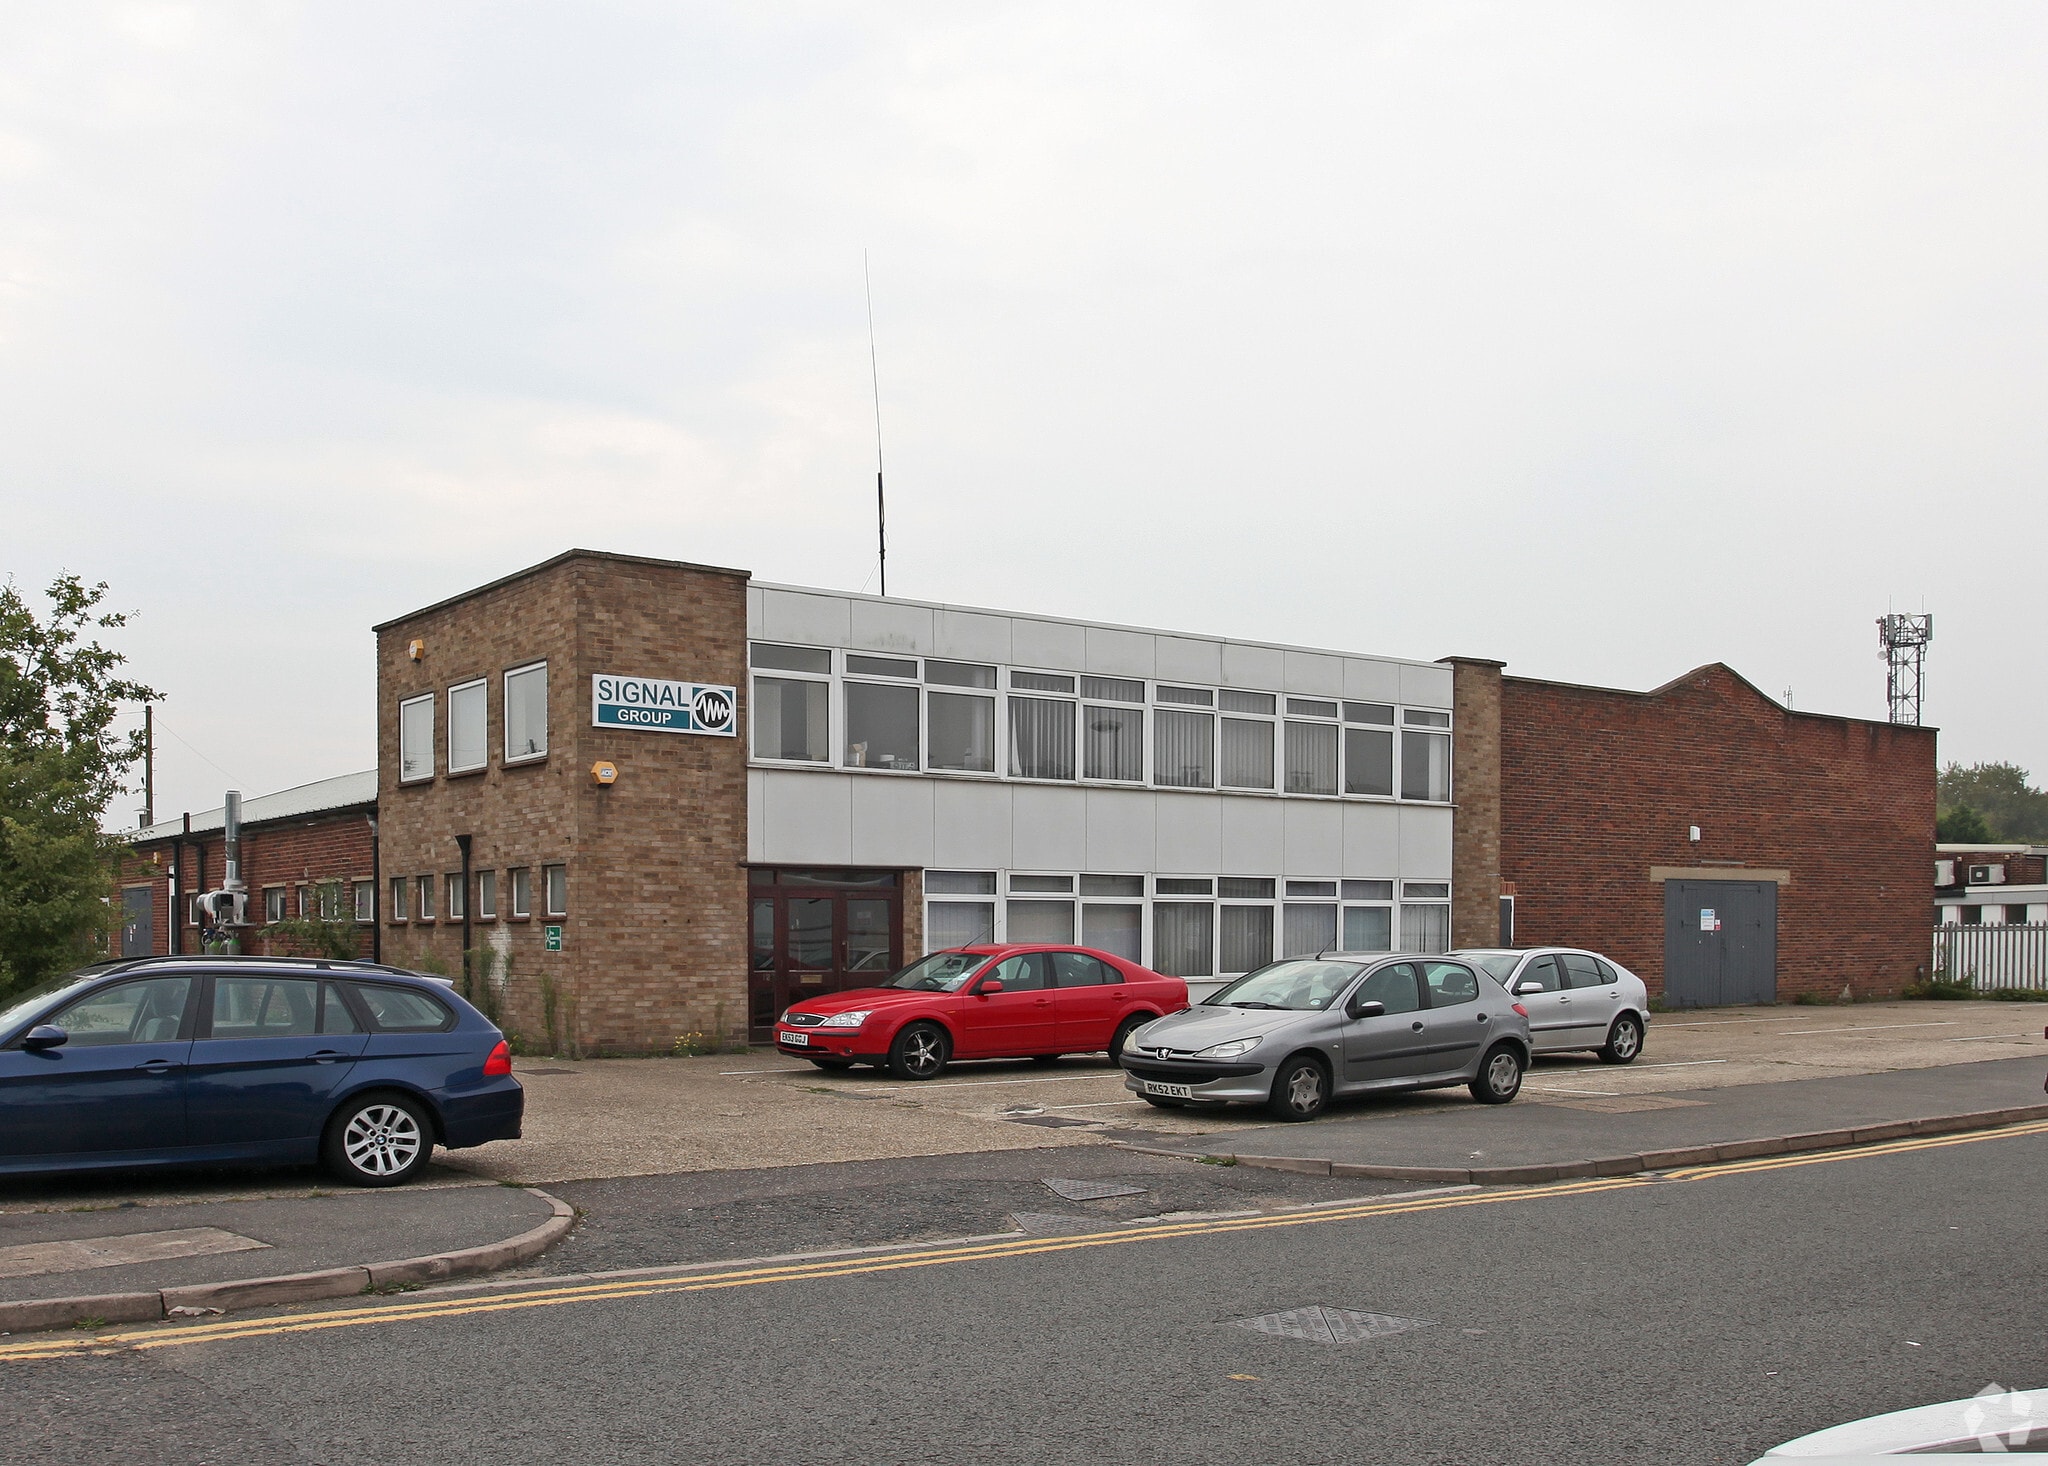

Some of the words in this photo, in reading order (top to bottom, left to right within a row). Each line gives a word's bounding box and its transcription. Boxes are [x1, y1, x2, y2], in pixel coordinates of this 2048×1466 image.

[598, 679, 690, 707] SIGNAL
[617, 708, 672, 724] GROUP
[1147, 1083, 1170, 1095] RK52
[1170, 1085, 1188, 1097] EKT
